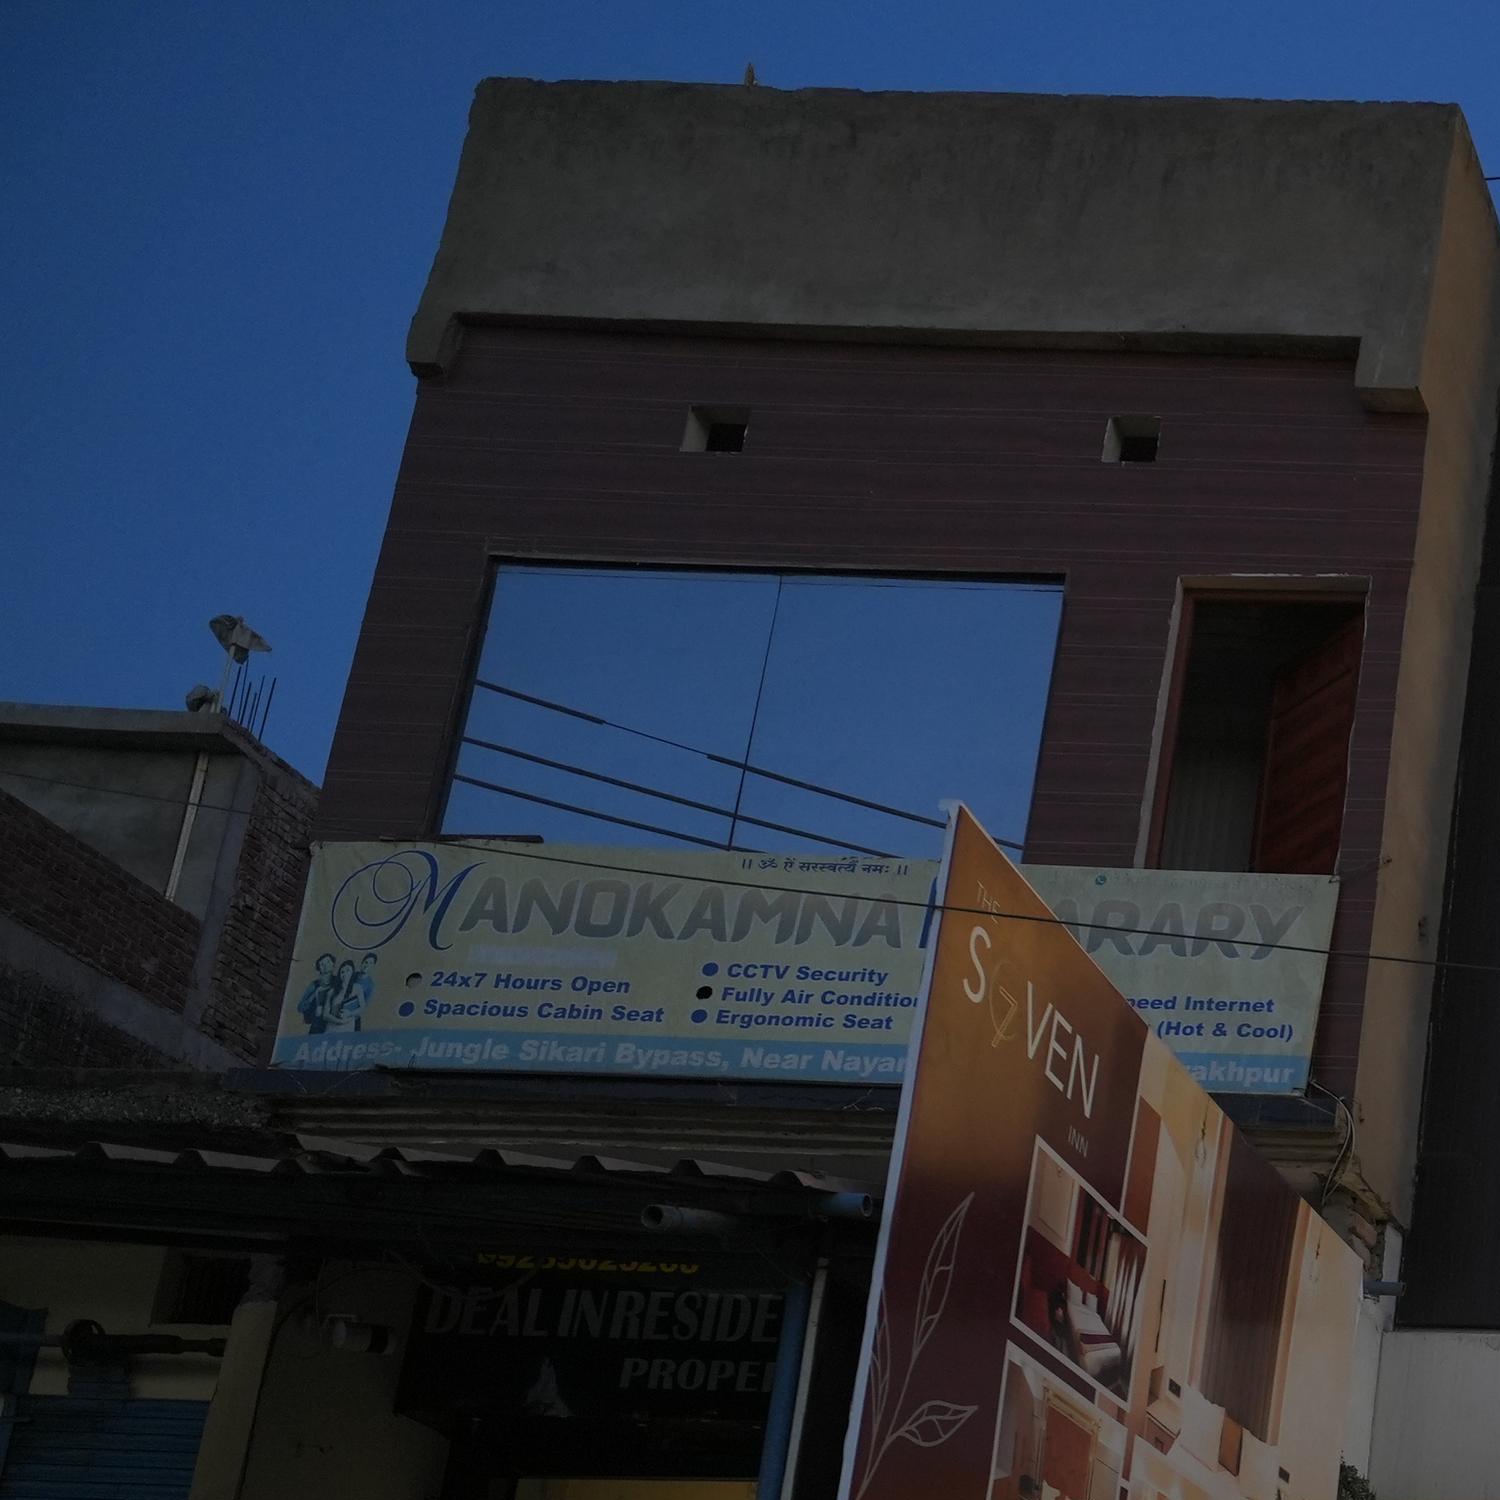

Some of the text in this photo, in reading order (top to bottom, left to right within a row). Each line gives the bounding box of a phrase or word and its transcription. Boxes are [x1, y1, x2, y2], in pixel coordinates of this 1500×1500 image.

[975, 880, 1001, 925] THE
[430, 971, 630, 995] 24x7 Hours Open
[727, 963, 889, 986] CCTV Security
[721, 987, 775, 1006] Fully
[780, 988, 814, 1005] Air
[1184, 995, 1275, 1013] Internet
[423, 1000, 665, 1023] Spacious Cabin Seat
[715, 1009, 894, 1030] Ergonomic Seat
[1157, 1021, 1294, 1042] (Hot & Cool)
[411, 1036, 510, 1064] Jungle
[518, 1038, 606, 1064] Sikari
[614, 1041, 731, 1071] Bypass,
[740, 1047, 815, 1070] Near
[424, 1284, 548, 1336] DEAL
[608, 1290, 786, 1343] RESIDE
